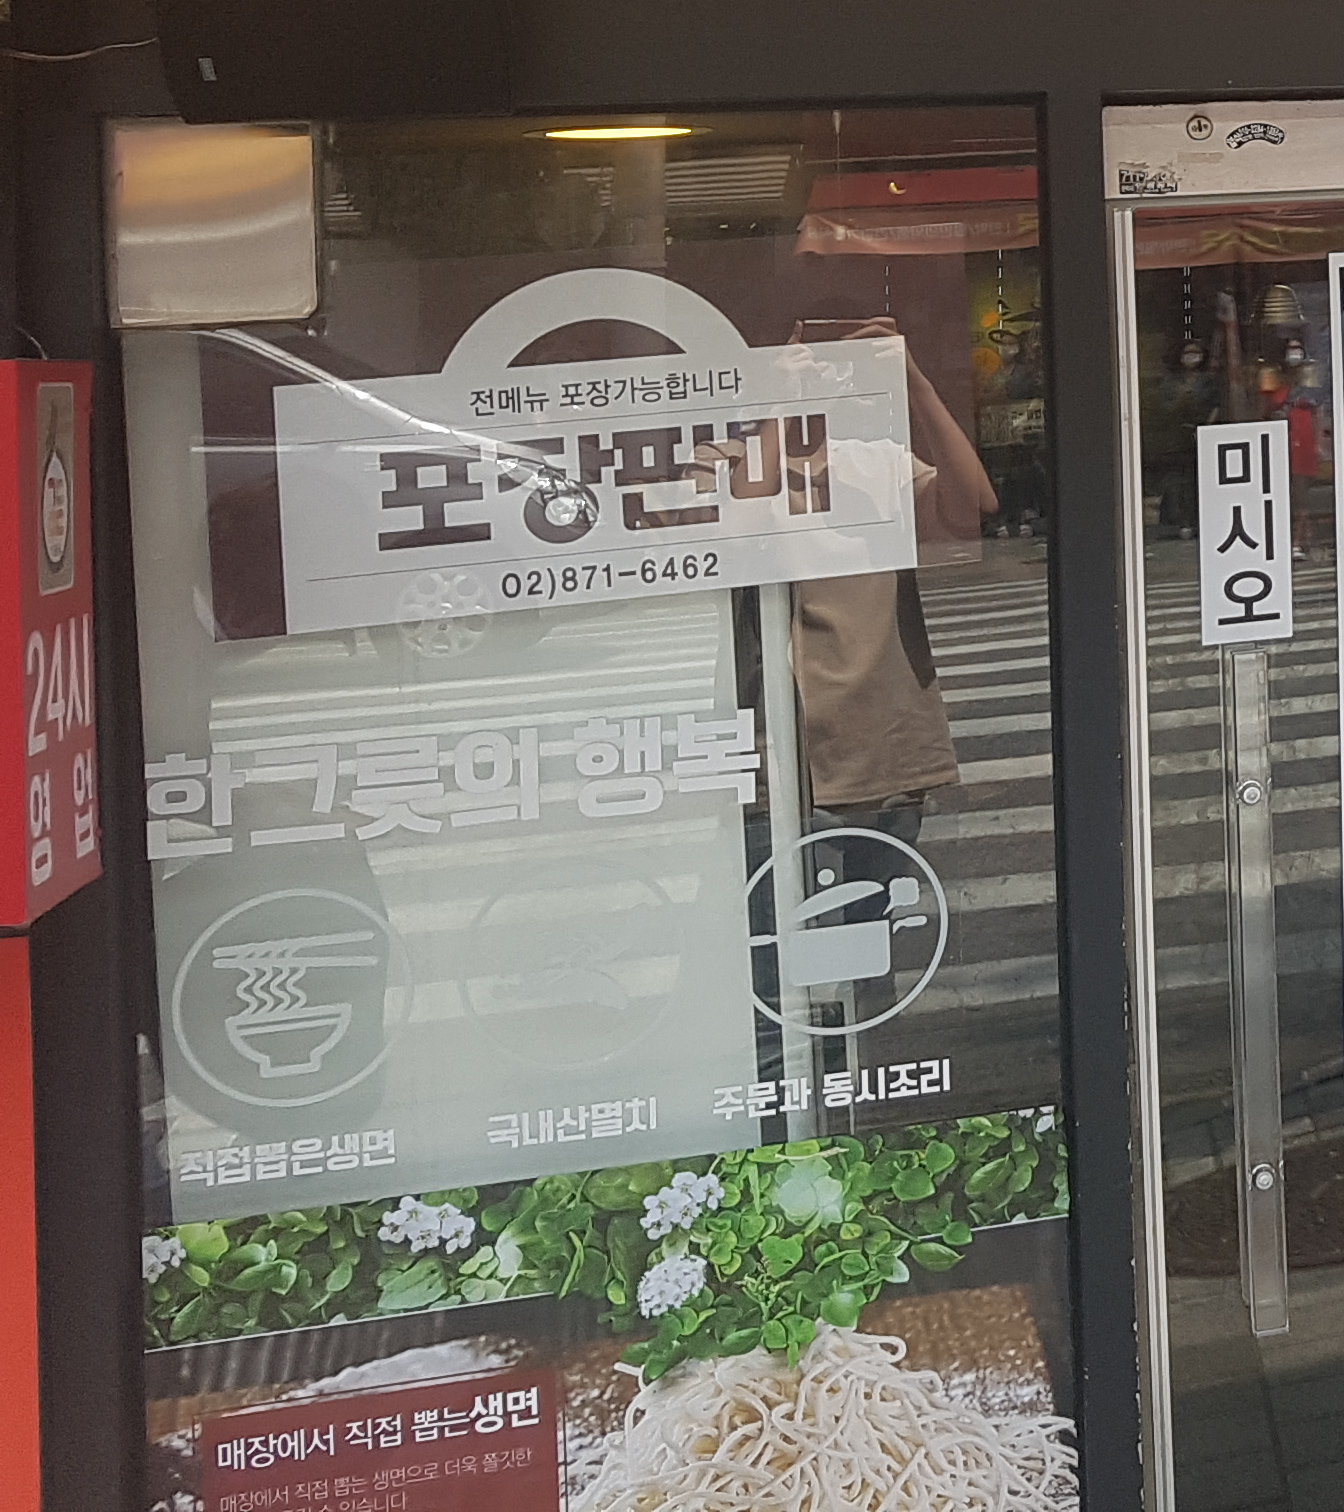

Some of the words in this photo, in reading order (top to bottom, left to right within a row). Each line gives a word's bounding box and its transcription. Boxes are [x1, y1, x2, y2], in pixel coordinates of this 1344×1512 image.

[469, 383, 550, 418] 전메뉴
[561, 368, 743, 410] 포장가능합니다
[378, 413, 832, 551] 포장판매
[1216, 431, 1284, 628] 미시오
[501, 552, 720, 601] 02)871-6462
[25, 613, 92, 756] 24시
[145, 728, 540, 860] 한그릇의
[576, 709, 760, 818] 행복
[712, 1080, 811, 1121] 주문과
[821, 1058, 952, 1110] 동시조리
[487, 1097, 658, 1150] 국내산멸치
[177, 1129, 396, 1187] 직접뽑은생면
[217, 1424, 335, 1470] 매장에서
[344, 1414, 402, 1450] 직접
[411, 1387, 540, 1439] 뽑는생면
[220, 1487, 289, 1512] 매장에서
[295, 1479, 329, 1503] 직접
[334, 1474, 367, 1497] 뽑는
[373, 1462, 438, 1489] 생면으로
[445, 1455, 477, 1475] 더욱
[483, 1447, 532, 1470] 쫄깃한
